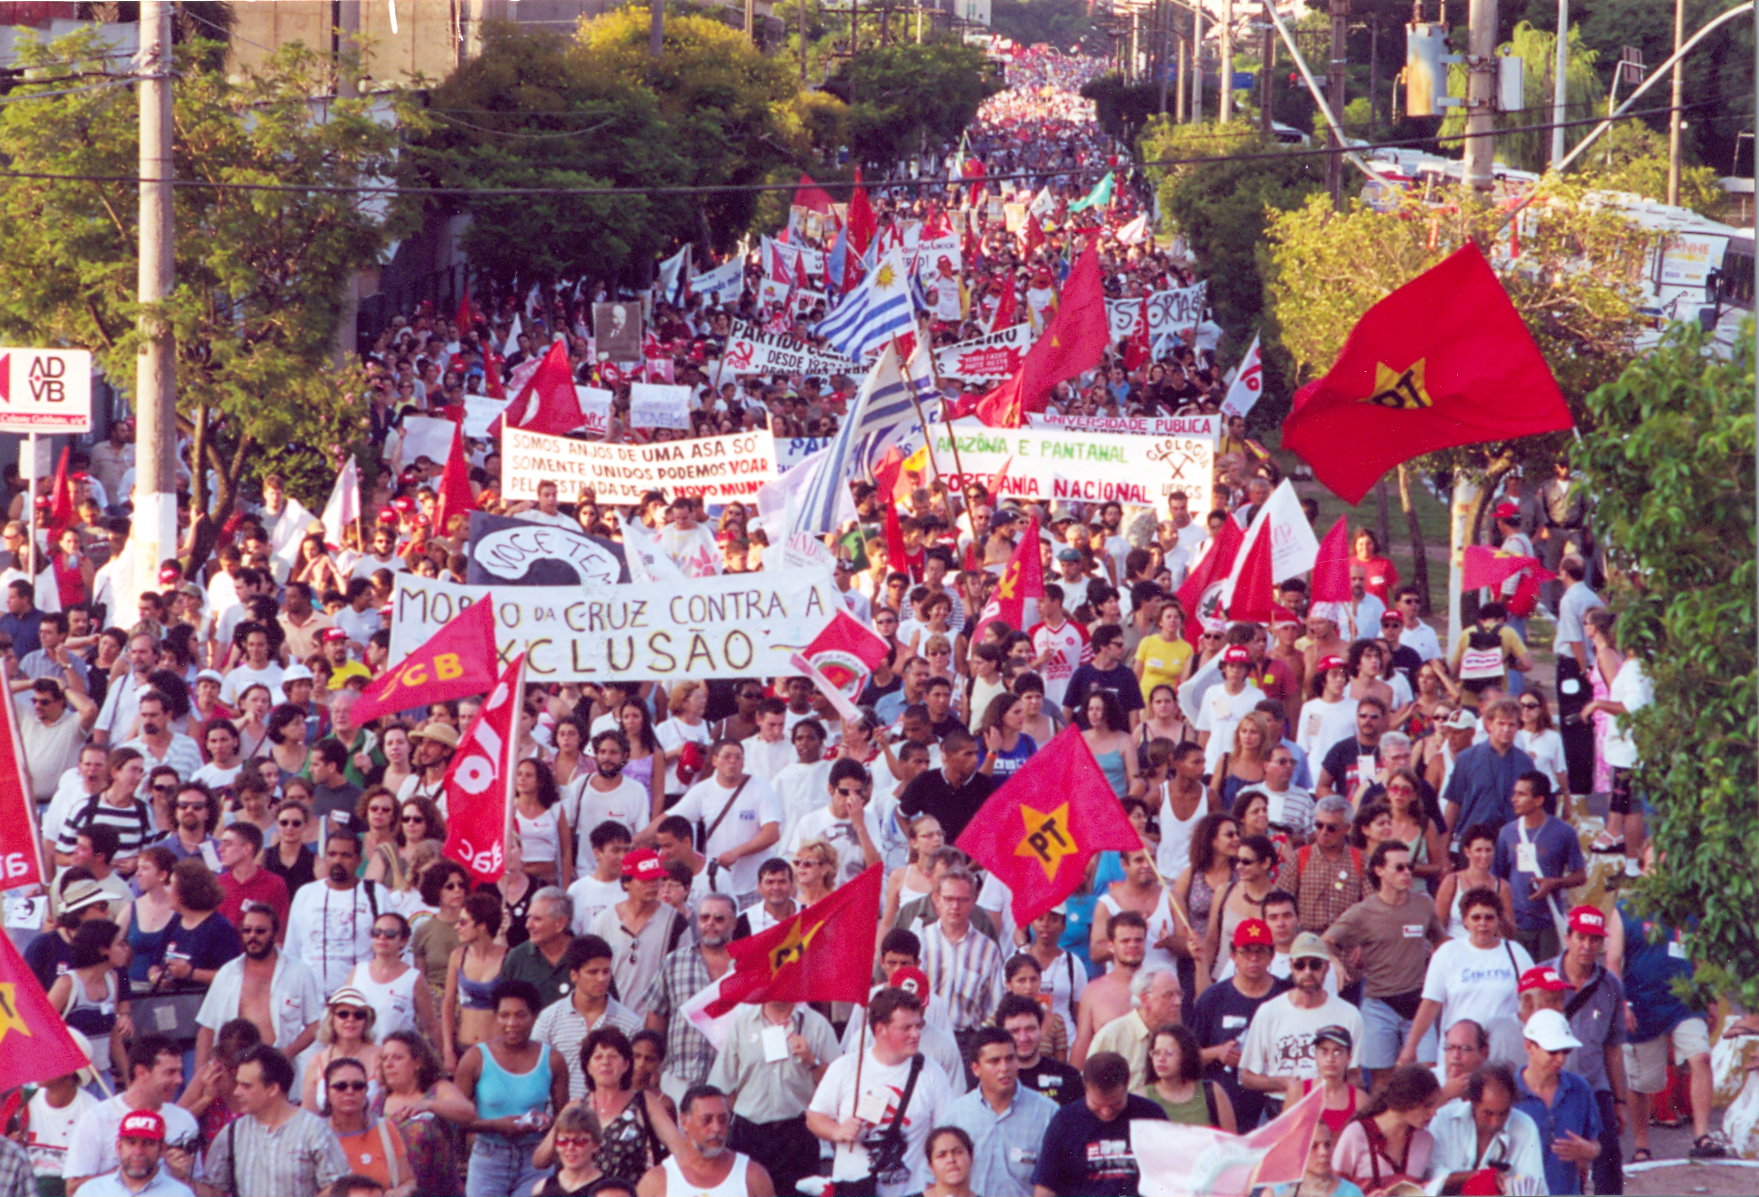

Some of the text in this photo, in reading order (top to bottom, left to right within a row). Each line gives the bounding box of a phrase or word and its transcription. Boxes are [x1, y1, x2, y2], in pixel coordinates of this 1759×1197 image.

[766, 349, 804, 369] DESDE
[28, 380, 66, 402] VB
[1043, 415, 1148, 431] UNIVERSIDADE
[512, 433, 560, 454] SOMOS
[568, 441, 614, 460] ANJOS
[617, 447, 638, 463] DE
[642, 445, 685, 463] UMA
[691, 440, 726, 459] ASA
[936, 433, 1130, 464] AMAZÔNIA E PANTANAL
[511, 455, 586, 476] SOMENTE
[591, 464, 654, 481] UNIDOS
[657, 461, 728, 481] PODEMOS
[728, 457, 769, 475] VOAR
[672, 485, 719, 498] NOVO
[719, 480, 766, 497] MUN
[1053, 478, 1153, 504] NACIONAL
[399, 585, 824, 632] MORO DA CRUZ CONTRA A
[496, 627, 754, 675] XCLUSÃO
[1028, 817, 1068, 863] PT
[124, 1116, 158, 1131] CUT
